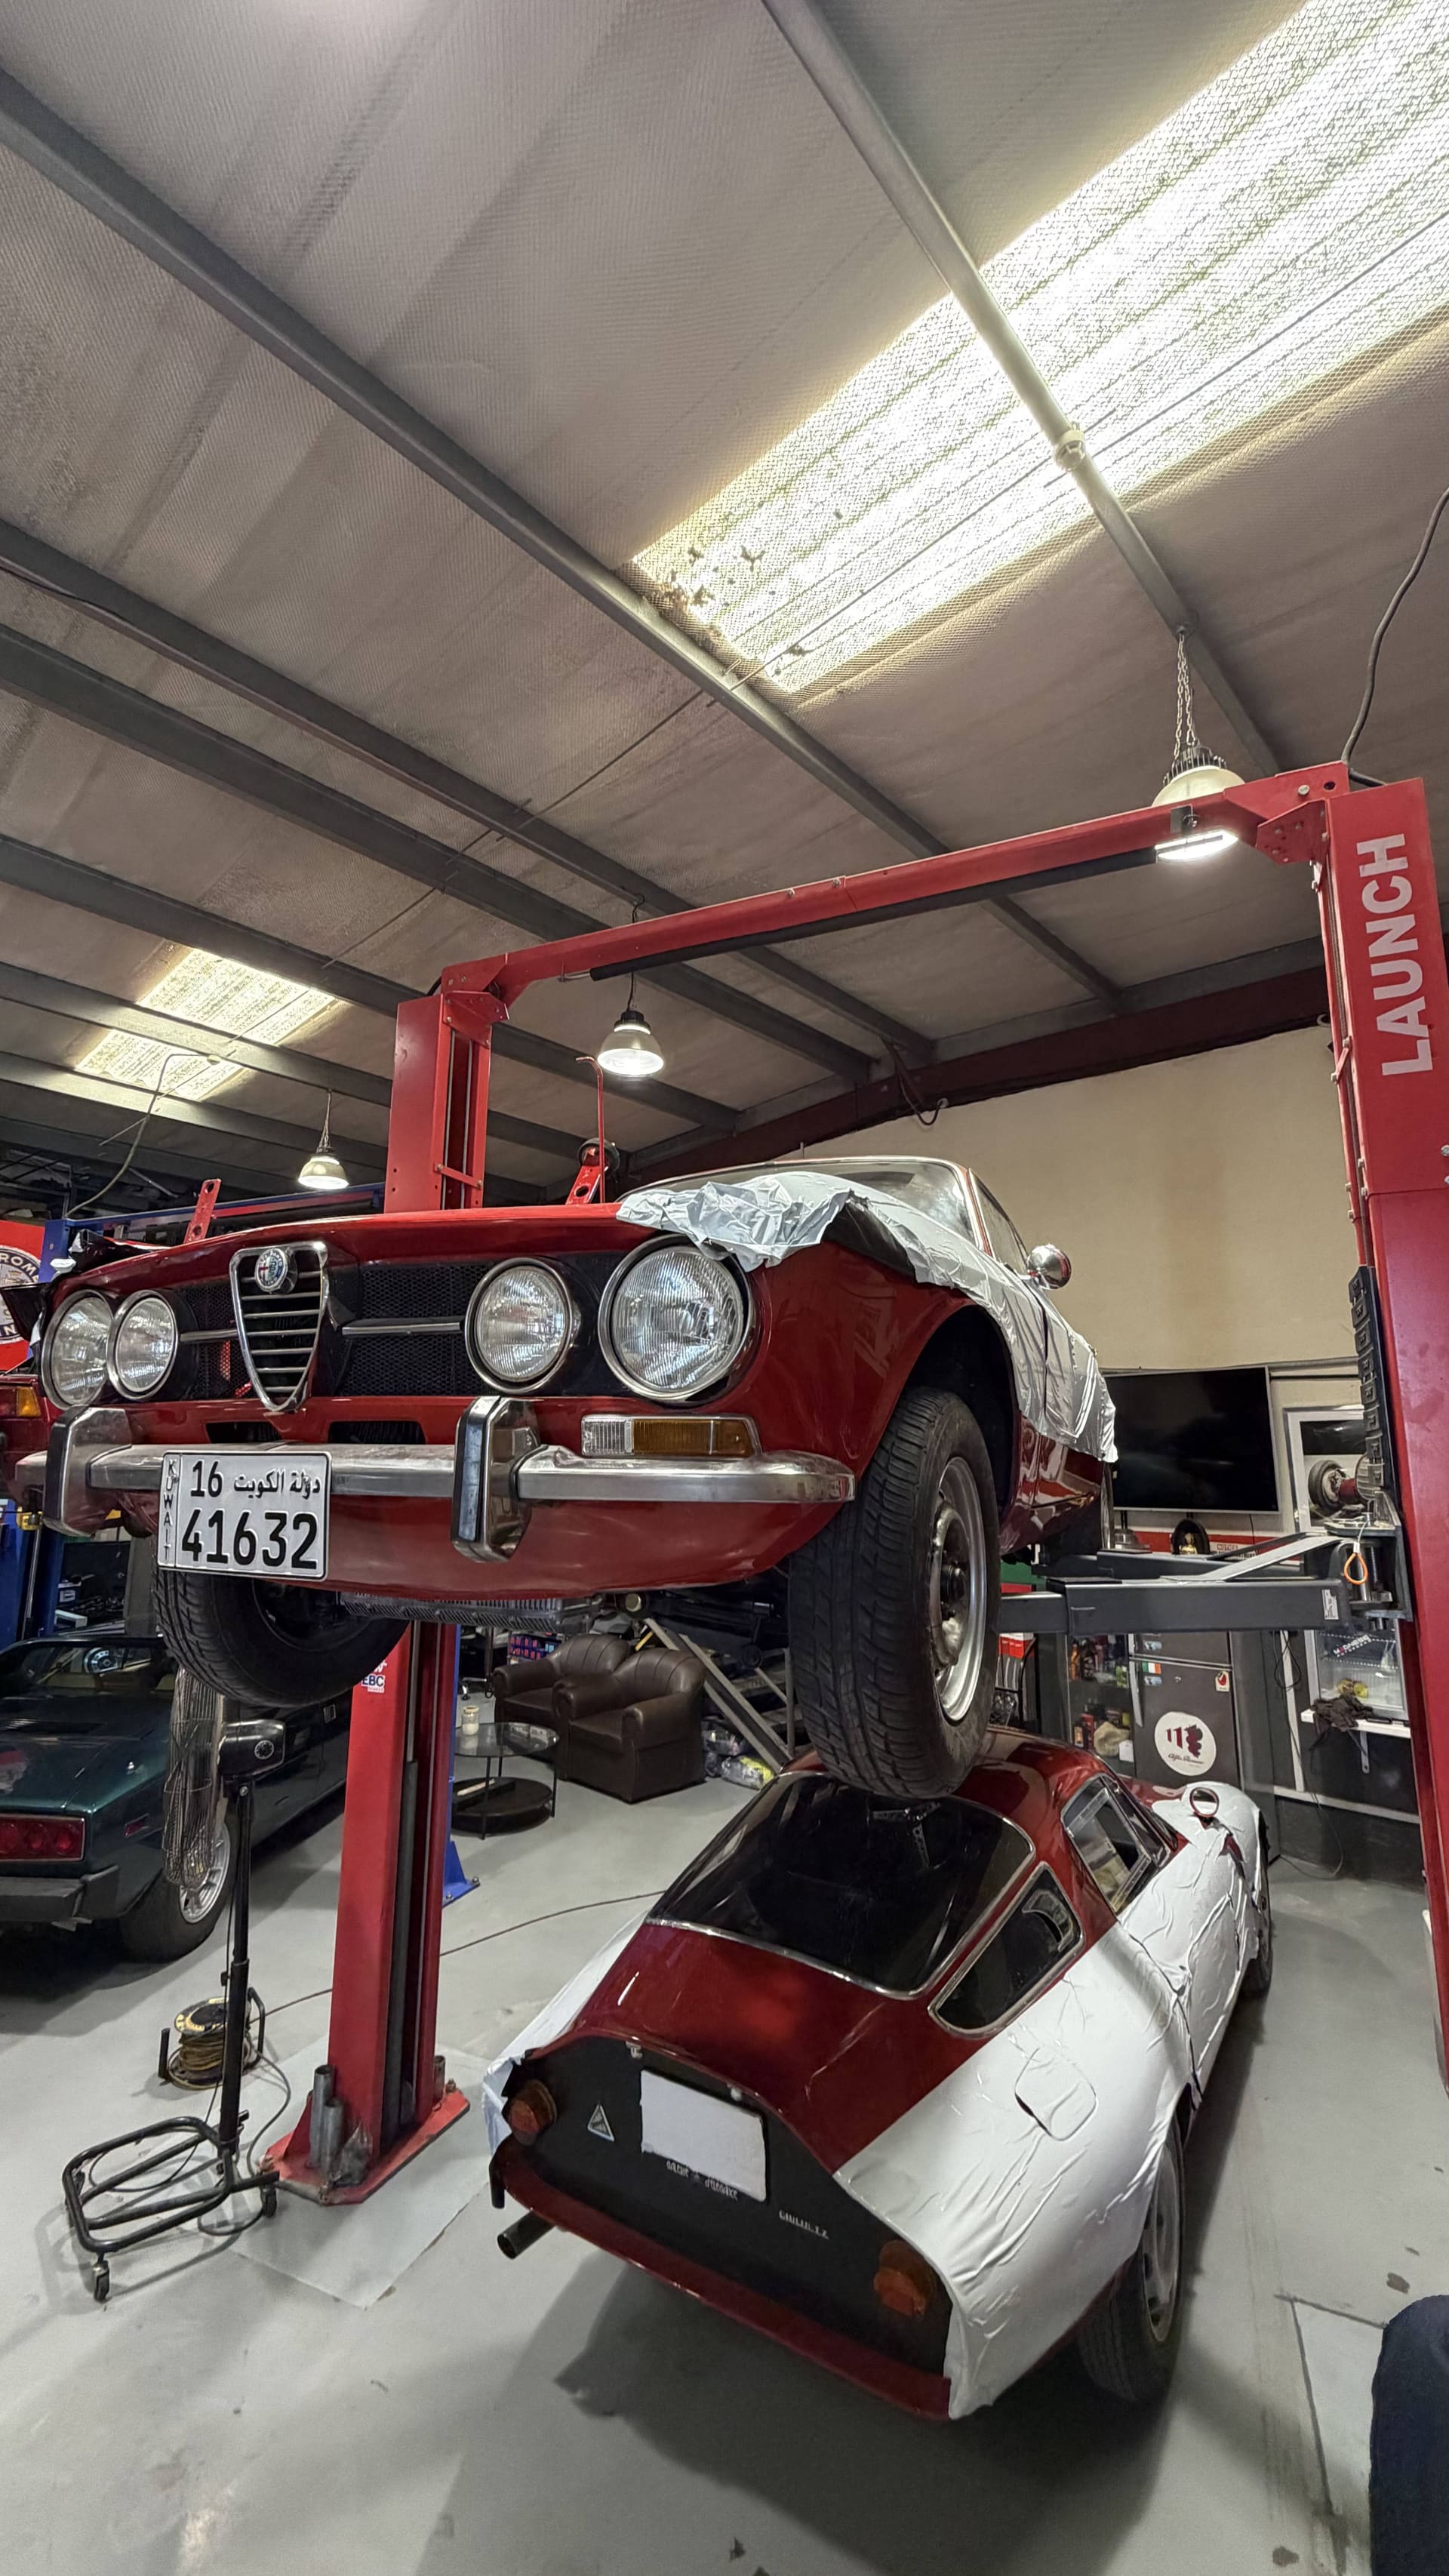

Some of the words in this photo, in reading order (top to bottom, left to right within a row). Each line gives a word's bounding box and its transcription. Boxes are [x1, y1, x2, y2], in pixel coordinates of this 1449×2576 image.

[1356, 833, 1433, 1076] LAUNCH
[191, 1460, 223, 1497] 16
[234, 1470, 285, 1499] الكويت
[290, 1470, 321, 1500] دولة
[163, 1459, 178, 1561] KUWAIT
[181, 1509, 317, 1570] 41632
[361, 1675, 384, 1687] EBC
